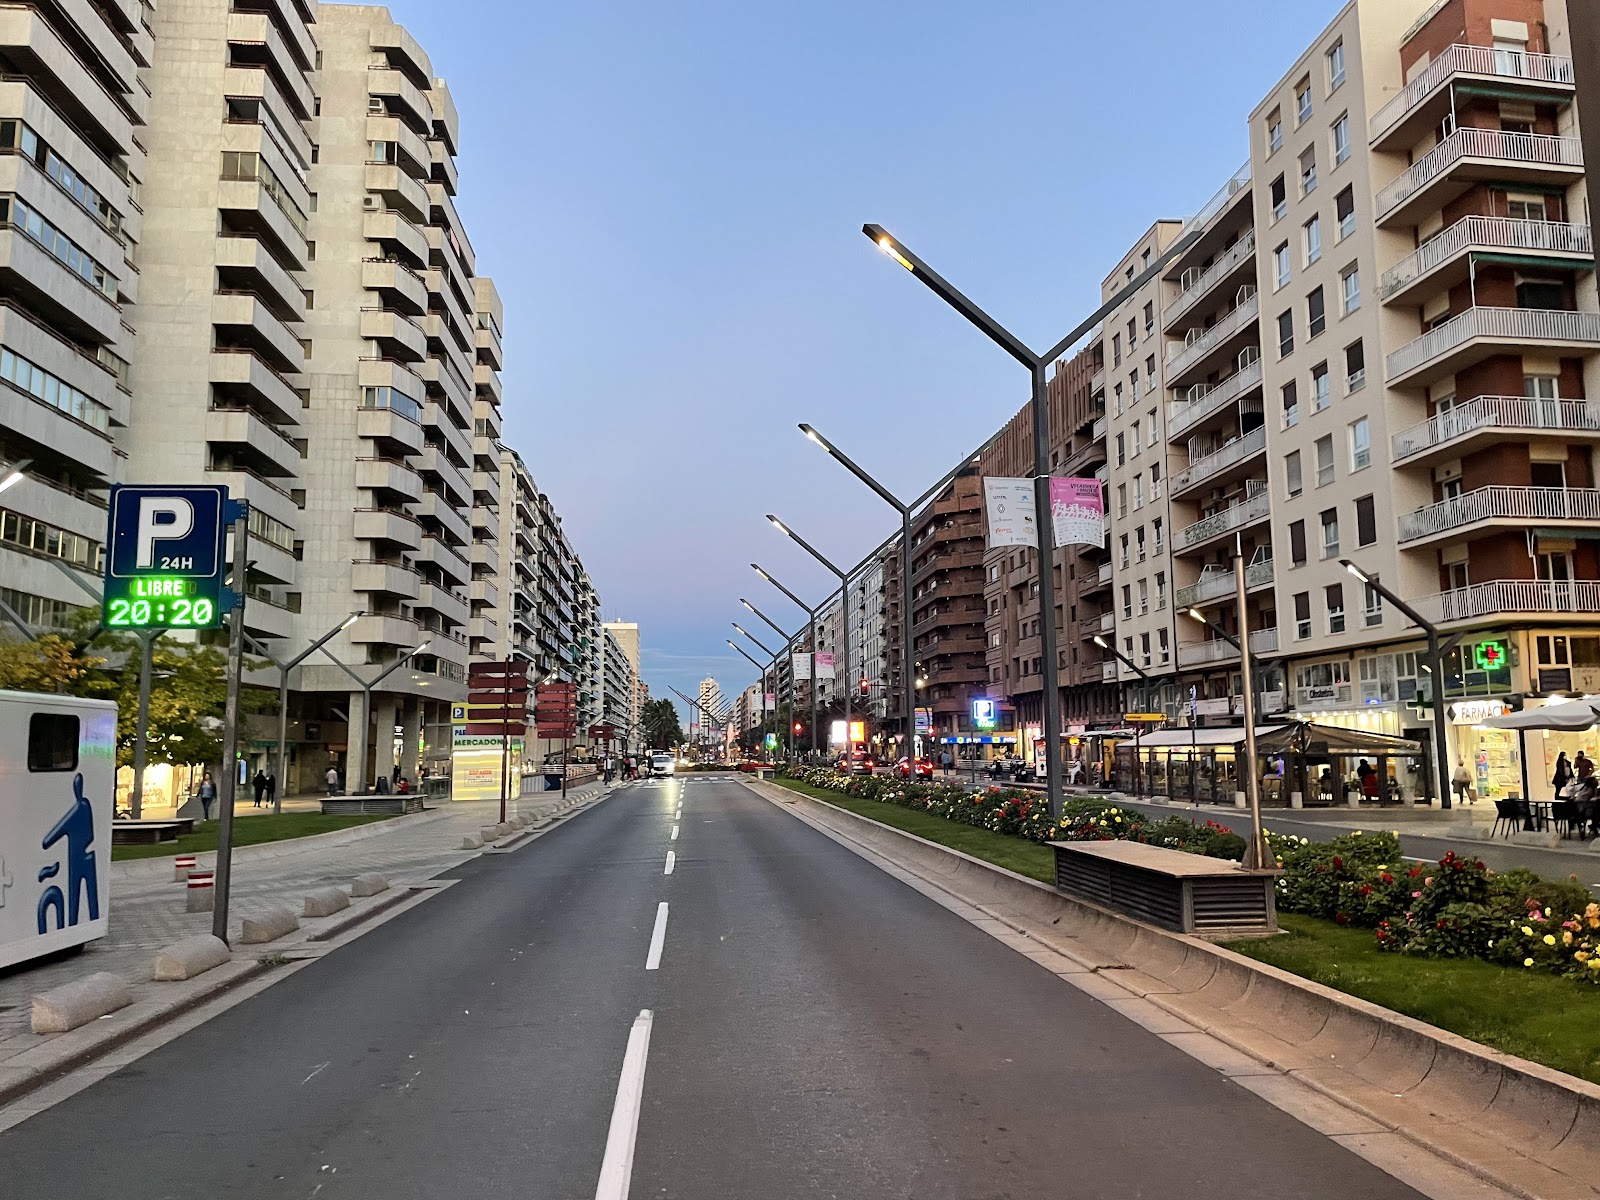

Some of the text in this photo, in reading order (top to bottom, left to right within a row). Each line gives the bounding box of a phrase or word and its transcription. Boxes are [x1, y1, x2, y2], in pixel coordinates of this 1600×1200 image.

[136, 496, 194, 569] P
[161, 557, 193, 570] 24H
[137, 579, 183, 597] LIBRE
[108, 599, 213, 626] 20:20
